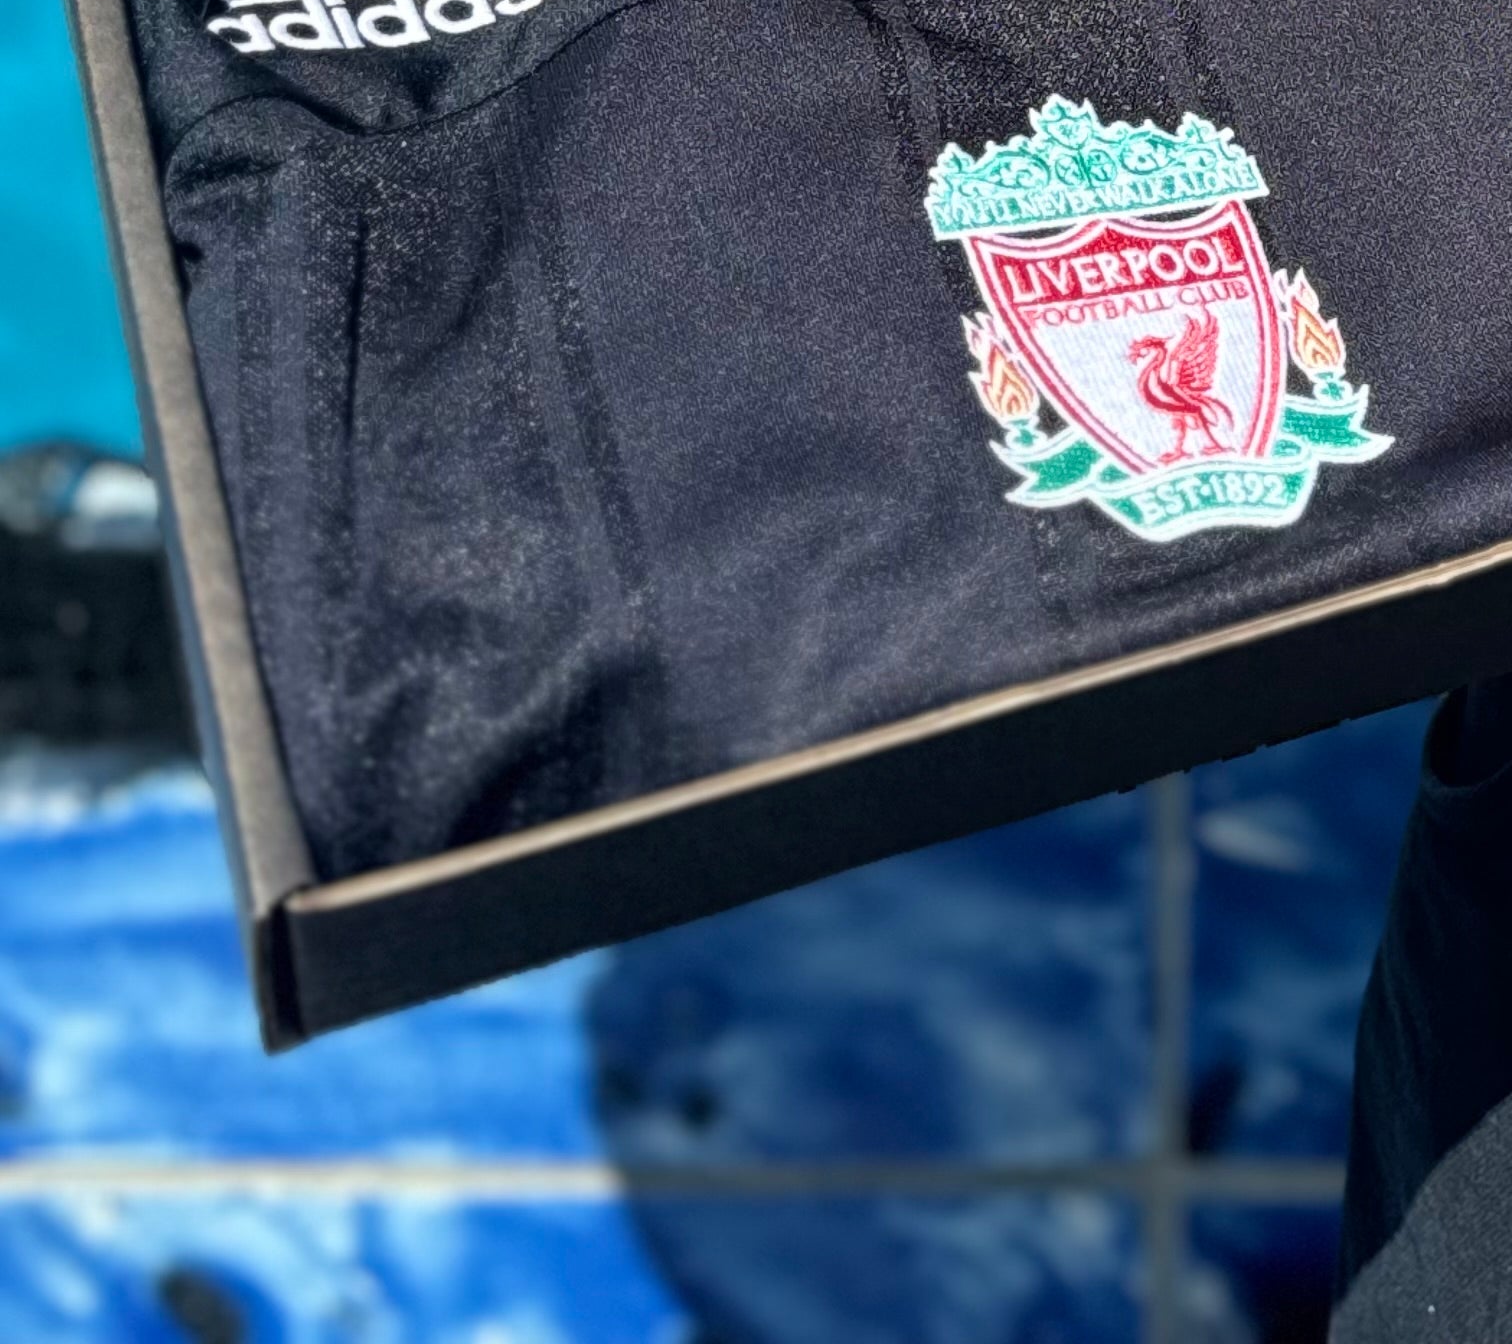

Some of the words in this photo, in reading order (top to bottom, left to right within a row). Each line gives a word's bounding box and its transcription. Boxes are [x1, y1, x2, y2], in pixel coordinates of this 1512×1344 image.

[1019, 184, 1102, 221] NEVER
[1095, 173, 1174, 209] WALK
[1174, 161, 1258, 198] ALONE
[1003, 236, 1244, 304] LIVERPOOL
[1025, 289, 1174, 327] FOOTBALL
[1177, 279, 1249, 307] CLUB
